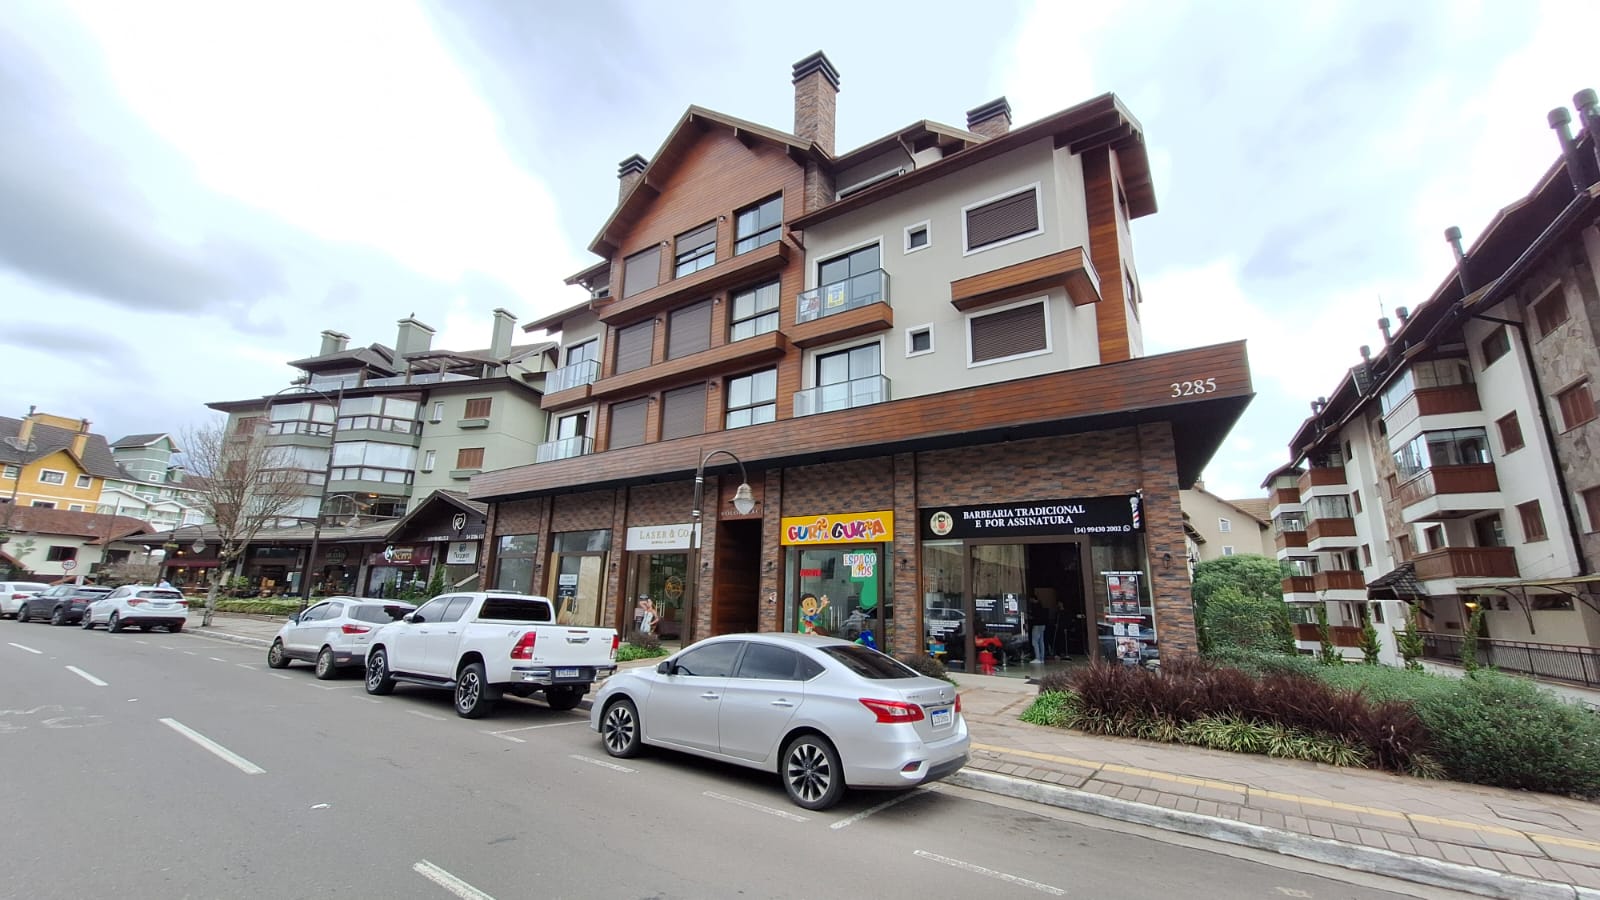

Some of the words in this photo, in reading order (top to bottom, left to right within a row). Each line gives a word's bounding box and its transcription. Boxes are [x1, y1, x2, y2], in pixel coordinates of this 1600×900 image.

[1170, 378, 1216, 398] 3285
[963, 509, 1014, 520] BARBEARIA
[1016, 505, 1086, 517] TRADICIONAL
[975, 520, 982, 528] E
[985, 518, 1005, 528] POR
[1007, 515, 1073, 527] ASSINATURA
[639, 530, 667, 540] LASER
[677, 528, 689, 538] CO
[843, 553, 876, 566] ESPAÇO
[852, 565, 872, 577] KIDS
